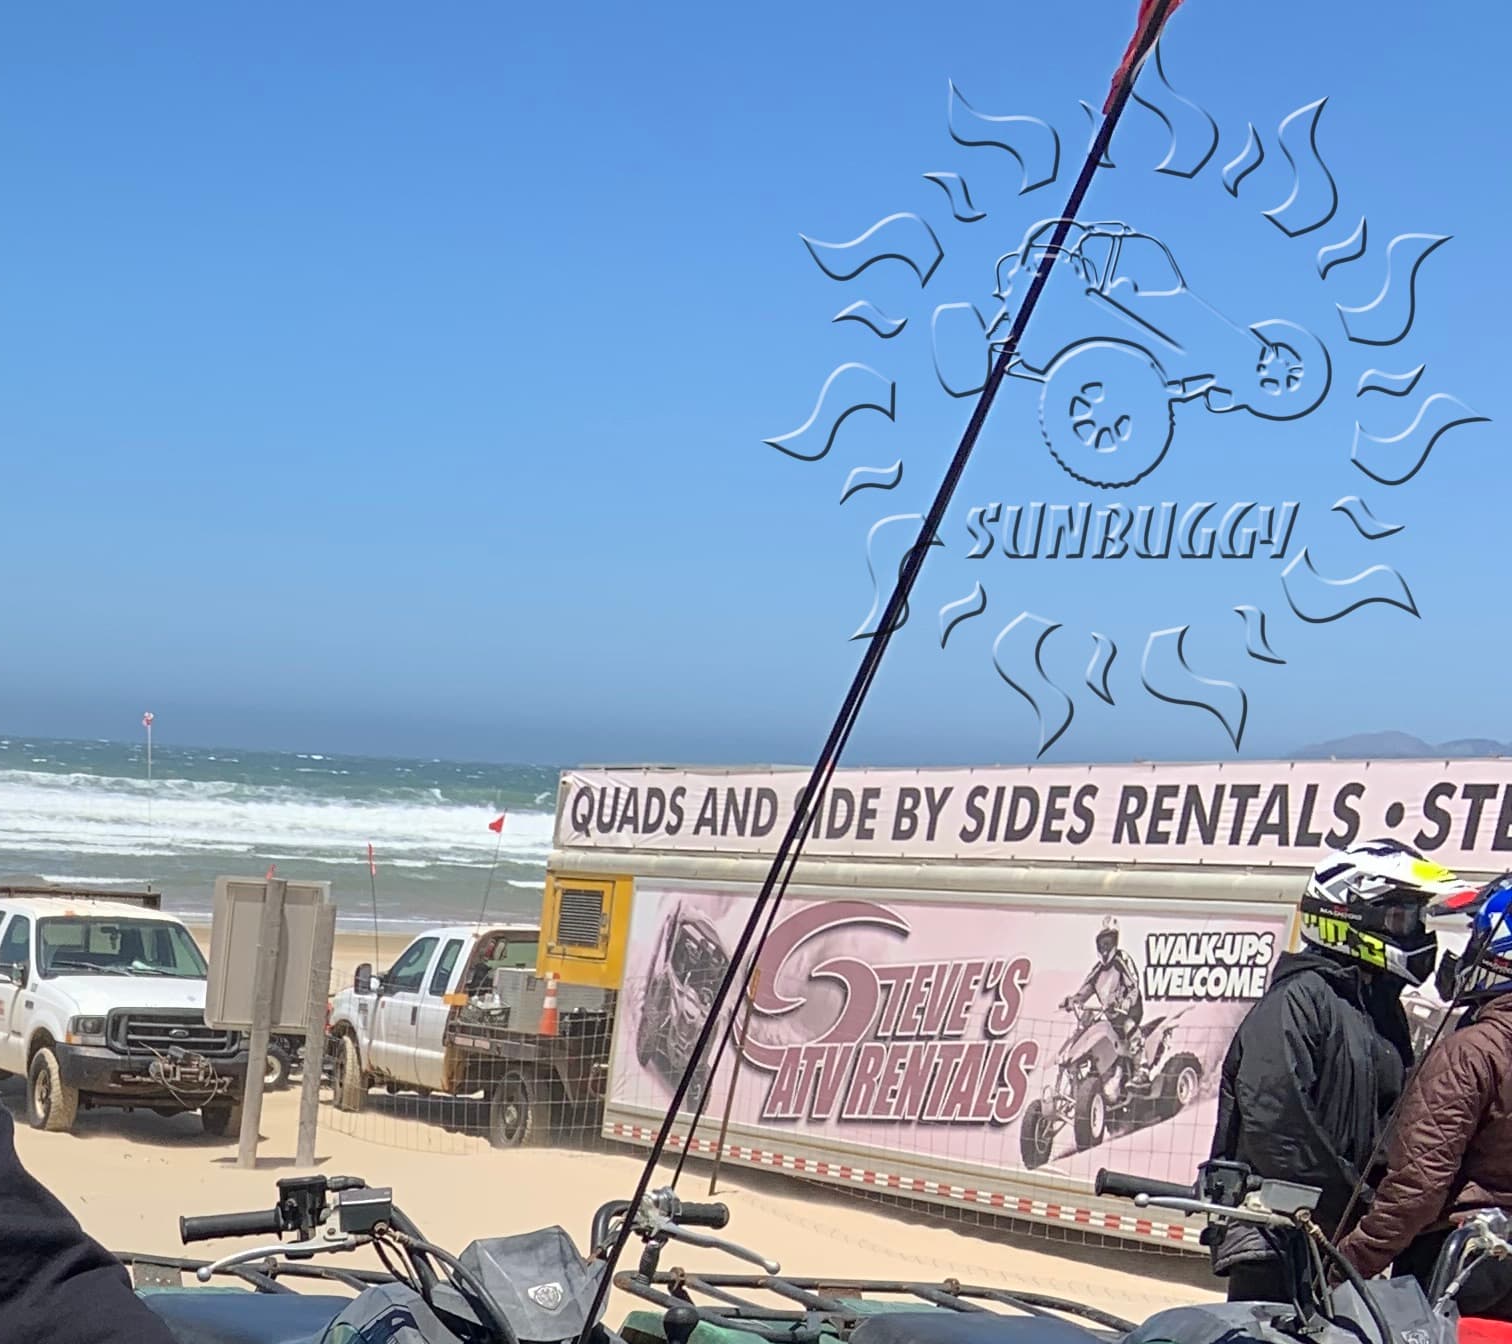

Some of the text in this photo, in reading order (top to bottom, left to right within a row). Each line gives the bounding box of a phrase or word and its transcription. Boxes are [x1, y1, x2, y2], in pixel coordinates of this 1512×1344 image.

[571, 785, 687, 838] QUADS
[692, 786, 778, 838] AND
[891, 786, 954, 842] BY
[959, 785, 1099, 845] SIDES
[1112, 783, 1367, 850] RENTALS
[1144, 965, 1268, 999] WELCOME
[1145, 931, 1275, 967] WALK-UPS
[734, 900, 1032, 1070] STEVE'S
[761, 1038, 1041, 1123] ATV RENTALS
